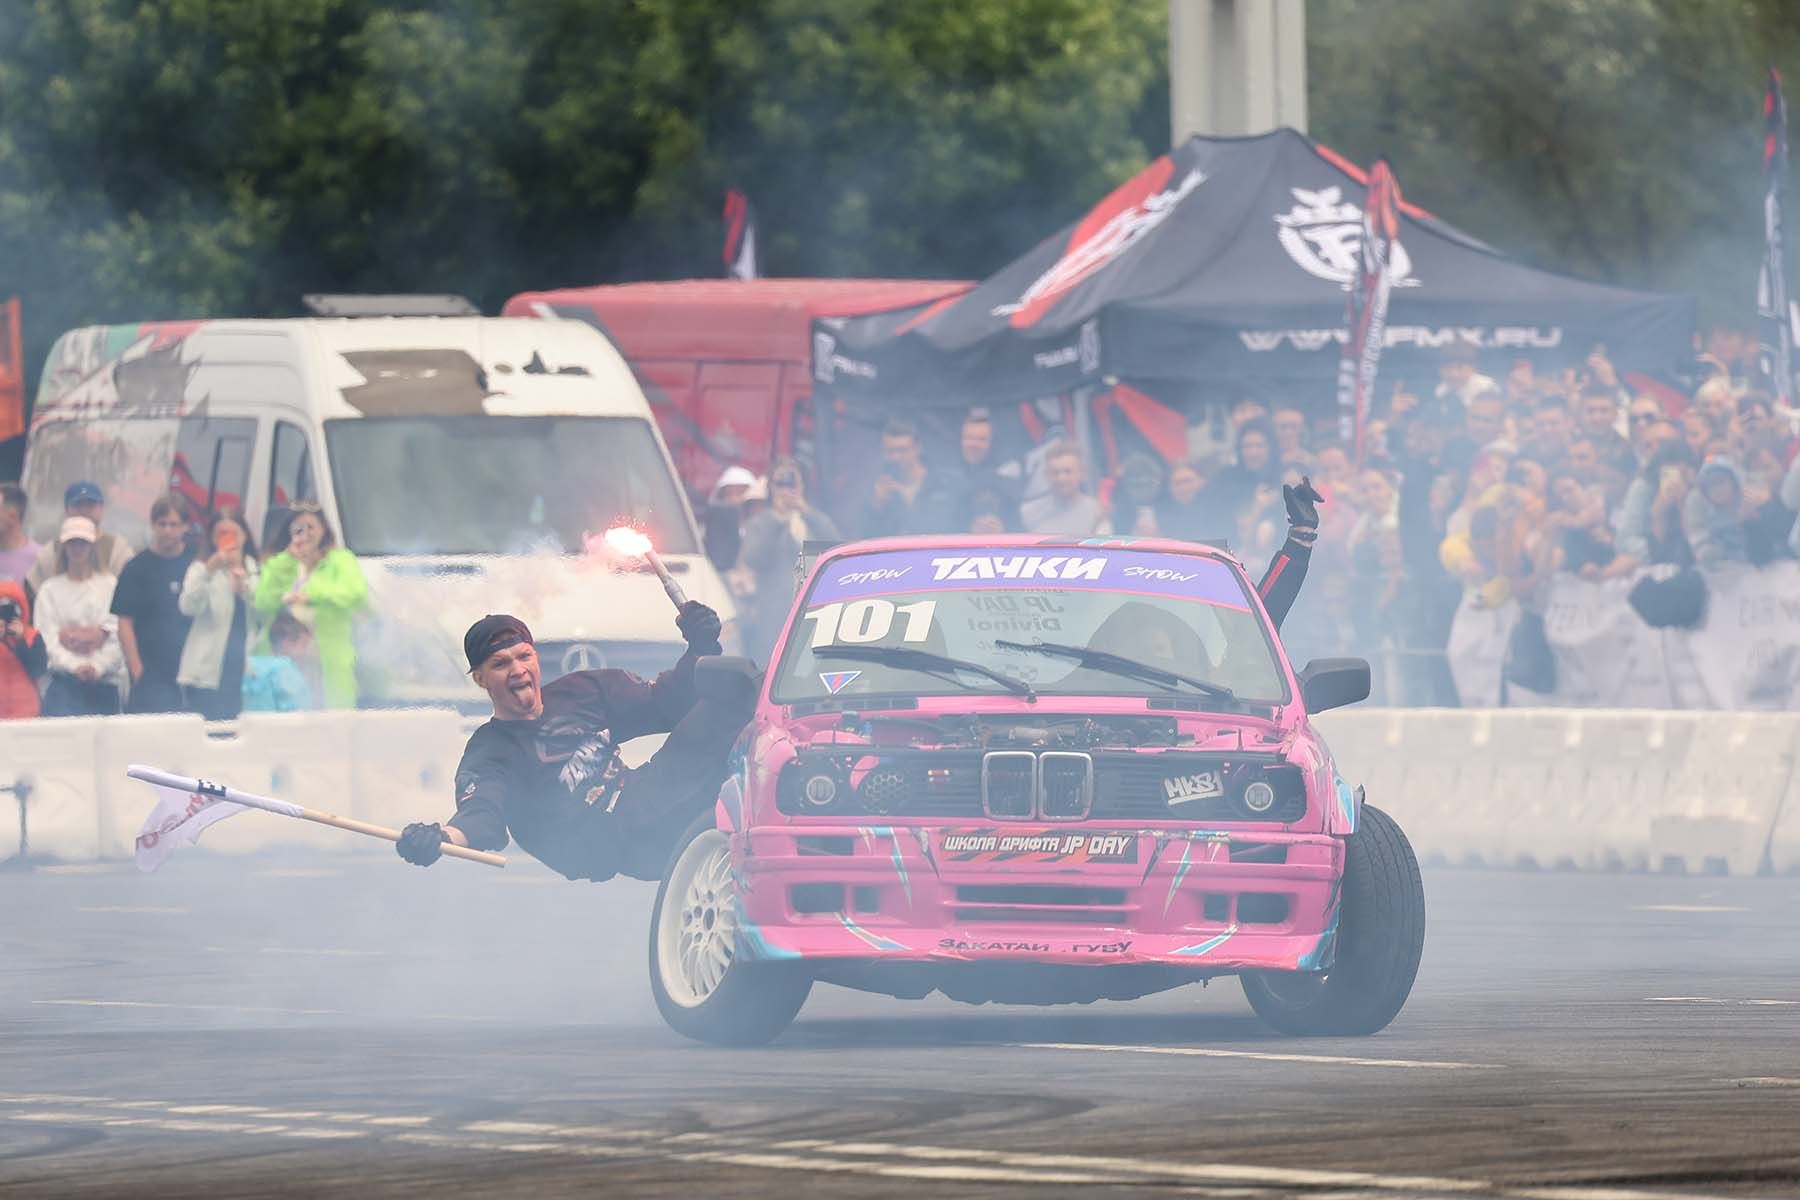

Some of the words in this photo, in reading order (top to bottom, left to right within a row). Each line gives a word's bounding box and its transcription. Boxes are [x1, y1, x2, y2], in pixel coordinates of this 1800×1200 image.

[838, 566, 912, 586] SHOW
[931, 557, 1109, 581] ТАЧКИ
[1123, 566, 1198, 582] SHOW
[804, 600, 937, 649] 101
[944, 836, 996, 851] ШКОЛА
[999, 836, 1059, 852] ДРИФТА
[1060, 835, 1085, 855] JP
[1088, 836, 1131, 856] DAY
